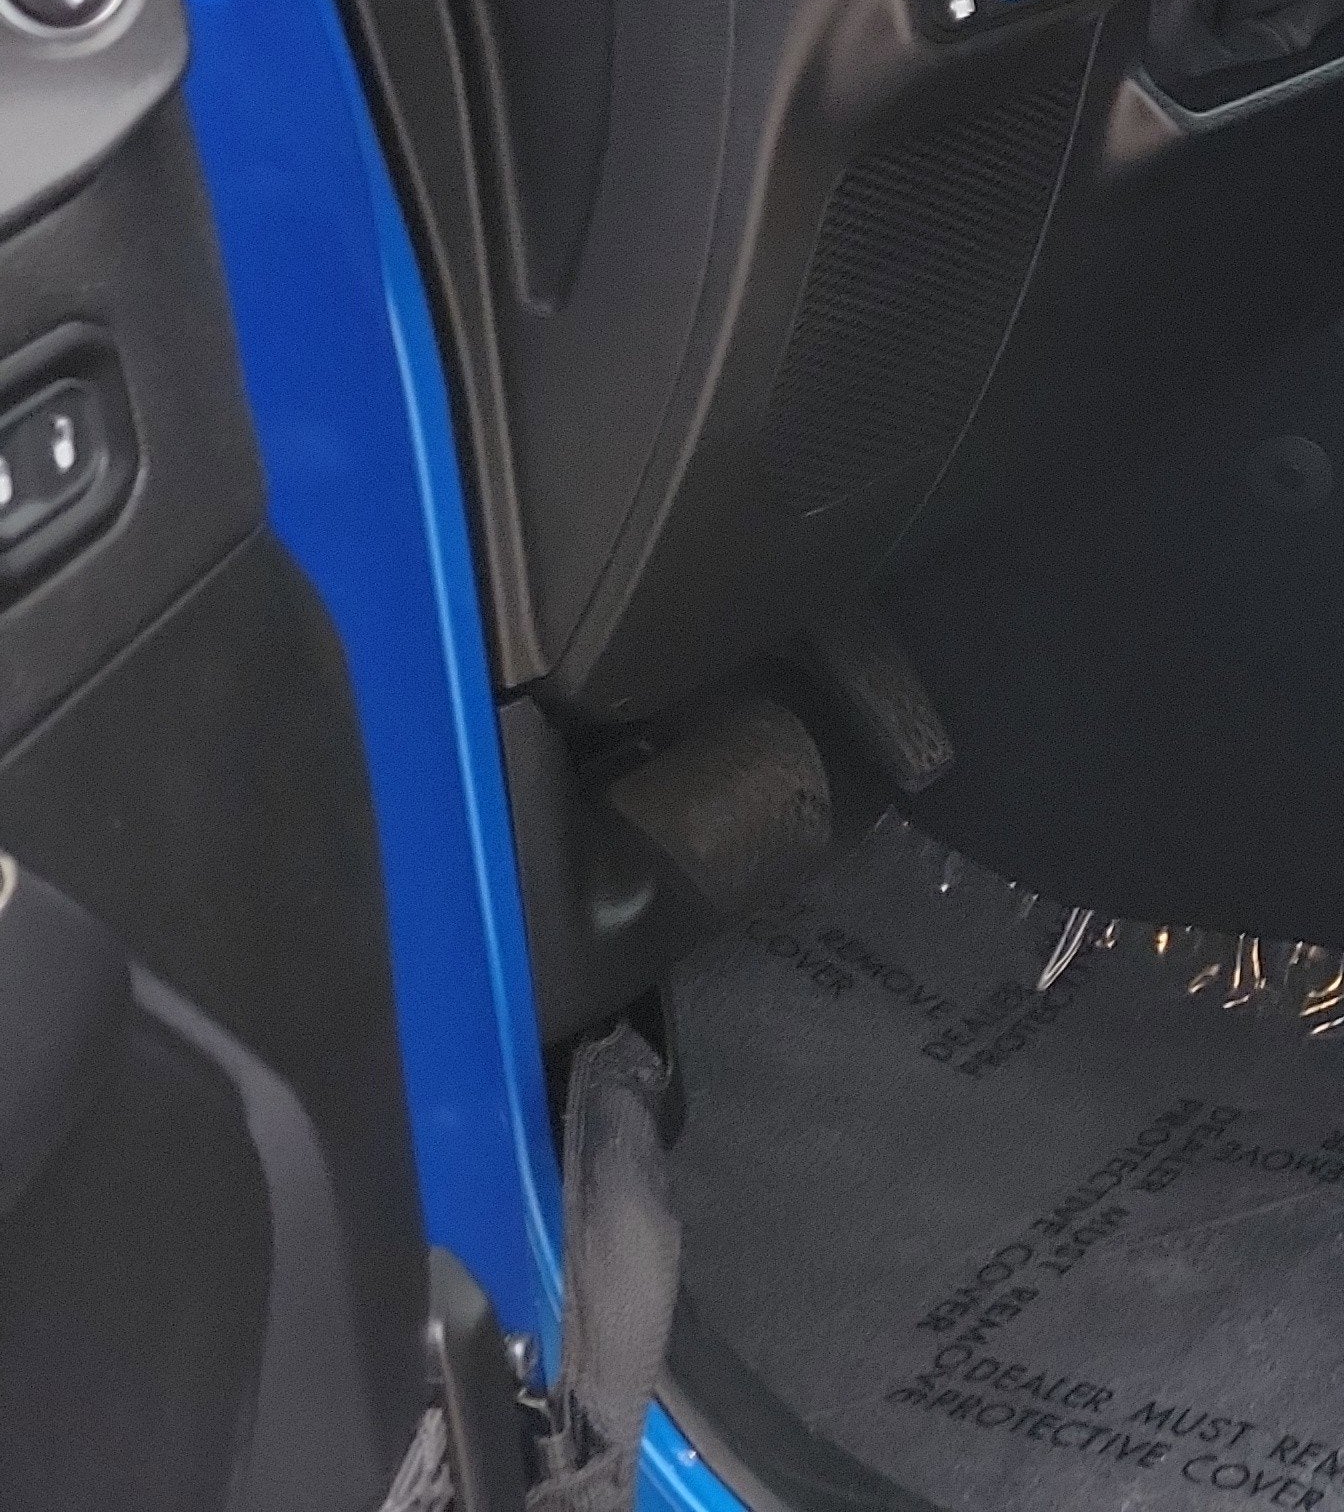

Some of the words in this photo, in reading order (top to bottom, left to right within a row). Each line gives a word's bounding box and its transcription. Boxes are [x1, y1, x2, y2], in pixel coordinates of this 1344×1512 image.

[747, 919, 853, 1000] COVER
[965, 1358, 1115, 1413] DEALER
[1129, 1400, 1257, 1450] MUST
[924, 1389, 1173, 1469] PROTECTIVE
[1180, 1454, 1326, 1512] COVER
